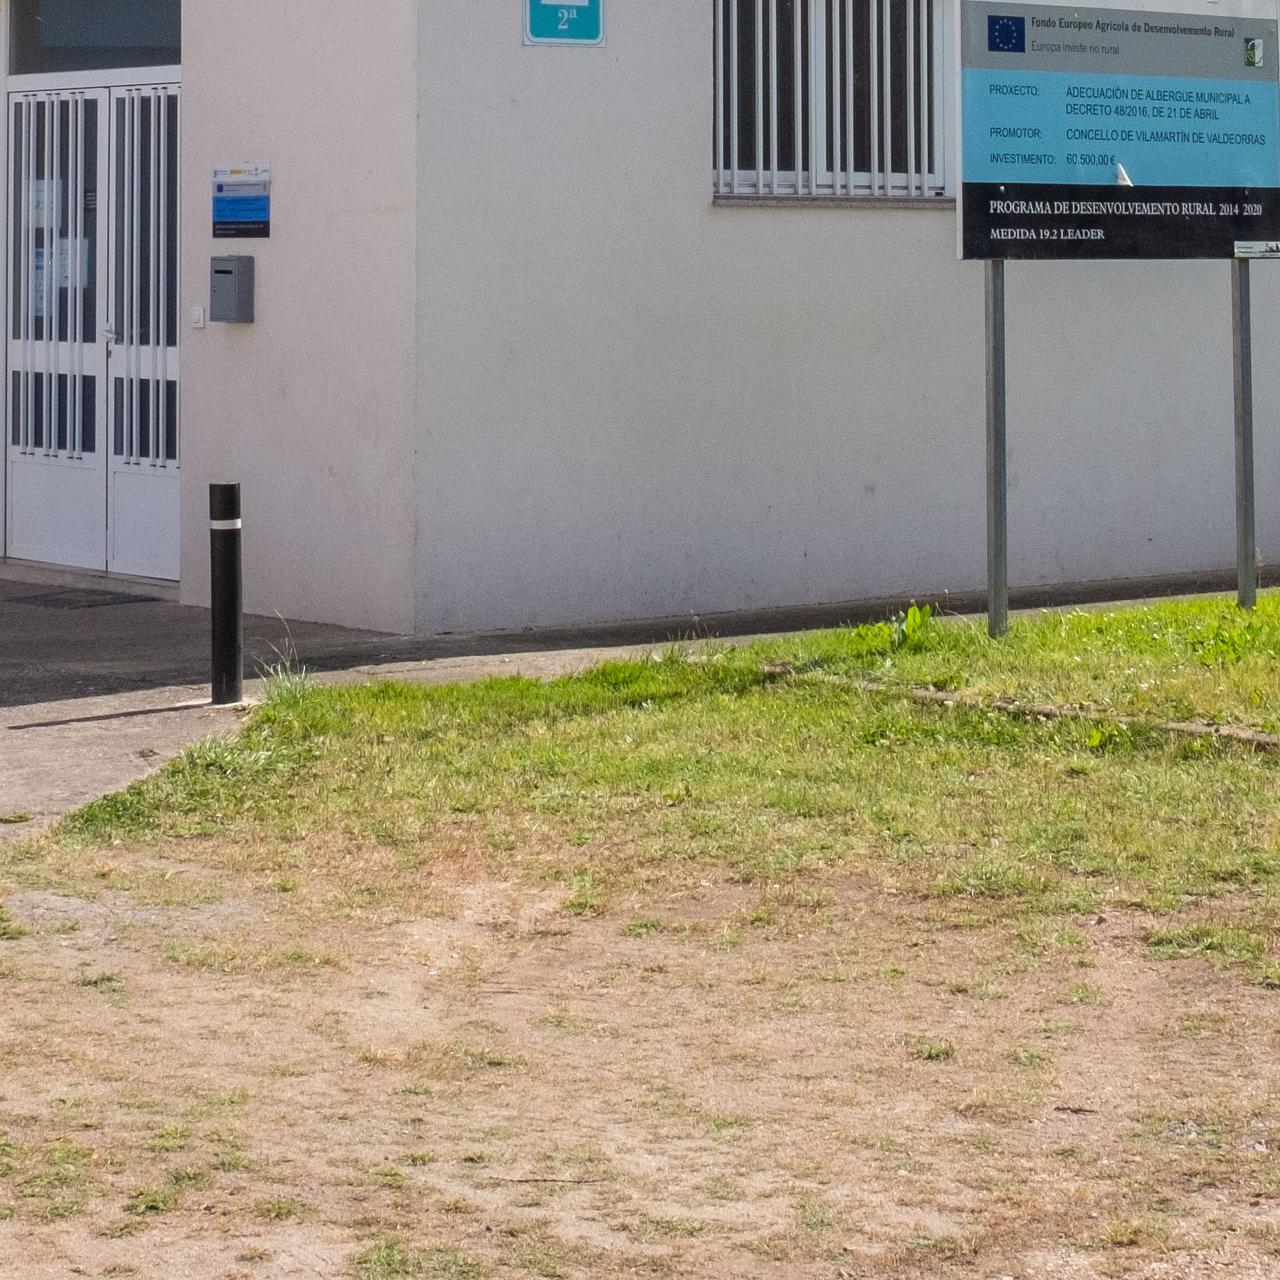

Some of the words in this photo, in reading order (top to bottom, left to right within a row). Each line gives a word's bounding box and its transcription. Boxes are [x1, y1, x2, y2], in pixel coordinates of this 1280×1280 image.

[1031, 16, 1057, 28] Fondo
[1059, 18, 1093, 31] Europeo
[1131, 22, 1141, 33] de
[1144, 23, 1212, 37] Desenvolvemento
[1214, 26, 1235, 38] Rural
[1031, 40, 1061, 53] Europa
[1062, 41, 1087, 53] inviste
[1089, 44, 1100, 54] no
[1101, 44, 1120, 55] rural
[989, 84, 1040, 96] PROXECTO:
[1066, 85, 1129, 100] ADECUACIÓN
[1131, 88, 1144, 100] DE
[1145, 89, 1195, 102] ALBERGUE
[1196, 91, 1243, 105] MUNICIPAL
[1244, 93, 1251, 105] A
[1066, 103, 1112, 116] DECRETO
[1114, 105, 1150, 118] 48/2016,
[1152, 106, 1165, 118] DE
[1167, 107, 1177, 118] 21
[1180, 107, 1192, 119] DE
[1194, 108, 1220, 120] ABRIL
[989, 127, 1043, 139] PROMOTOR:
[1066, 128, 1119, 141] CONCELLO
[1121, 130, 1134, 141] DE
[1192, 132, 1205, 144] DE
[1206, 132, 1266, 146] VALDEORRAS
[989, 153, 1057, 165] INVESTIMENTO:
[989, 200, 1052, 214] PROGRAMA
[1053, 201, 1070, 214] DE
[1071, 201, 1180, 215] DESENVOLVEMENTO
[1182, 202, 1217, 215] RURAL
[1219, 203, 1239, 216] 2014
[1243, 203, 1263, 216] 2020
[990, 228, 1037, 240] MEDIDA
[1039, 228, 1058, 240] 19.2
[1060, 228, 1105, 240] LEADER
